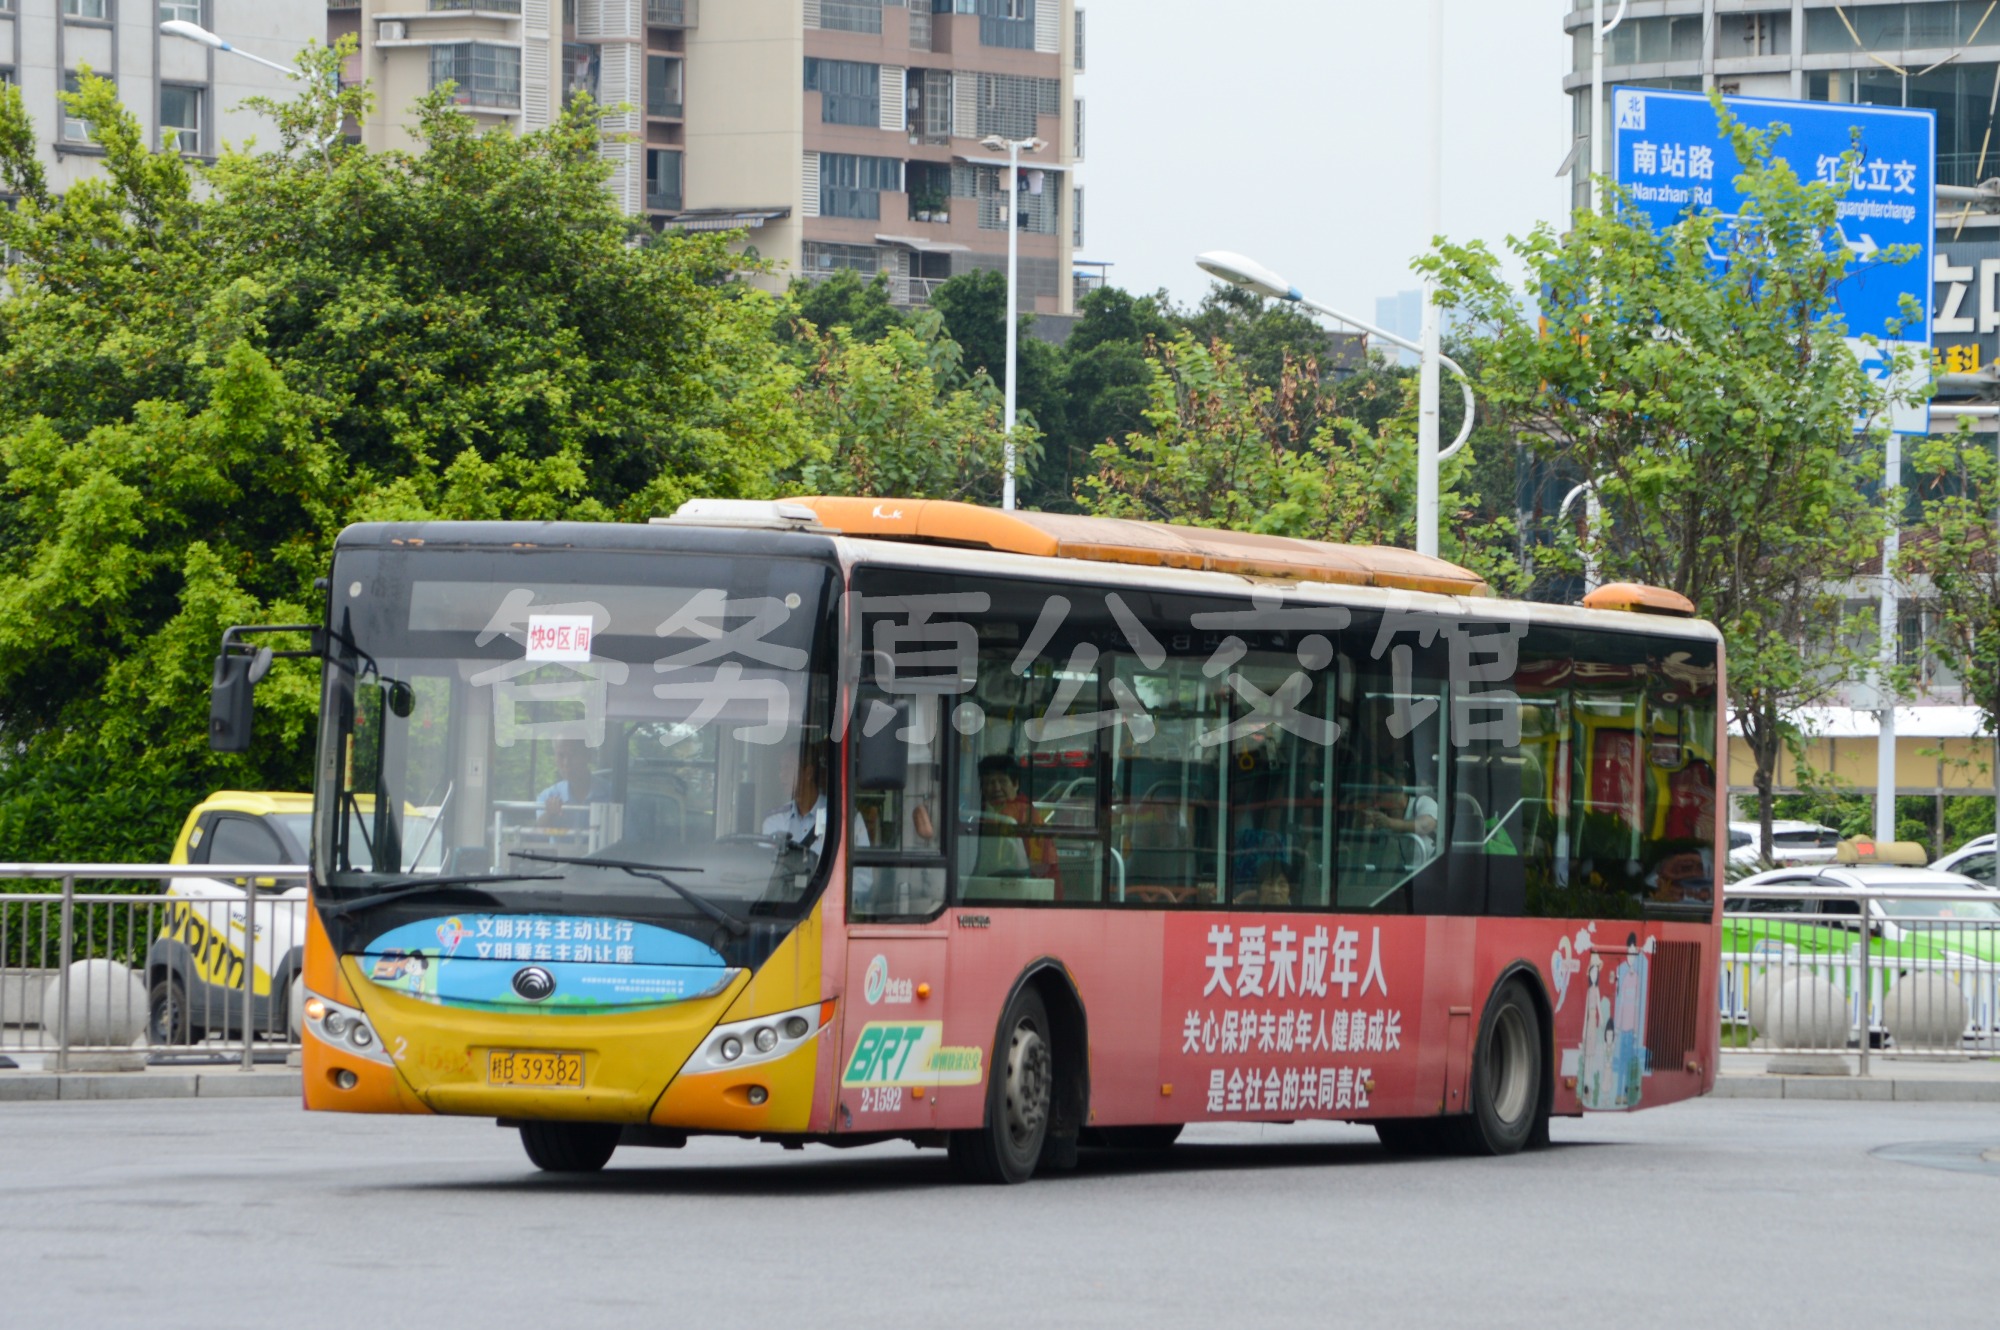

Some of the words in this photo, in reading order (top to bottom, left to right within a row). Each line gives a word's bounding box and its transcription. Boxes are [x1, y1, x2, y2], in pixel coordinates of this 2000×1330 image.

[1628, 96, 1641, 112] 北
[1632, 115, 1641, 128] N
[1632, 140, 1715, 180] 南站路
[1632, 181, 1688, 203] Nanzhan
[1694, 186, 1713, 205] Rd
[530, 625, 590, 651] 快9区间
[476, 918, 634, 942] 文明开车主动让行
[475, 941, 634, 963] 文明乘车主动让座
[1203, 924, 1388, 998] 关爱未成年人
[1182, 1009, 1402, 1054] 关心保护未成年人健康成长
[393, 1035, 408, 1061] 2
[844, 1026, 925, 1082] BRT
[860, 1086, 902, 1113] 2-1592
[1206, 1066, 1373, 1112] 是全社会的共同责任
